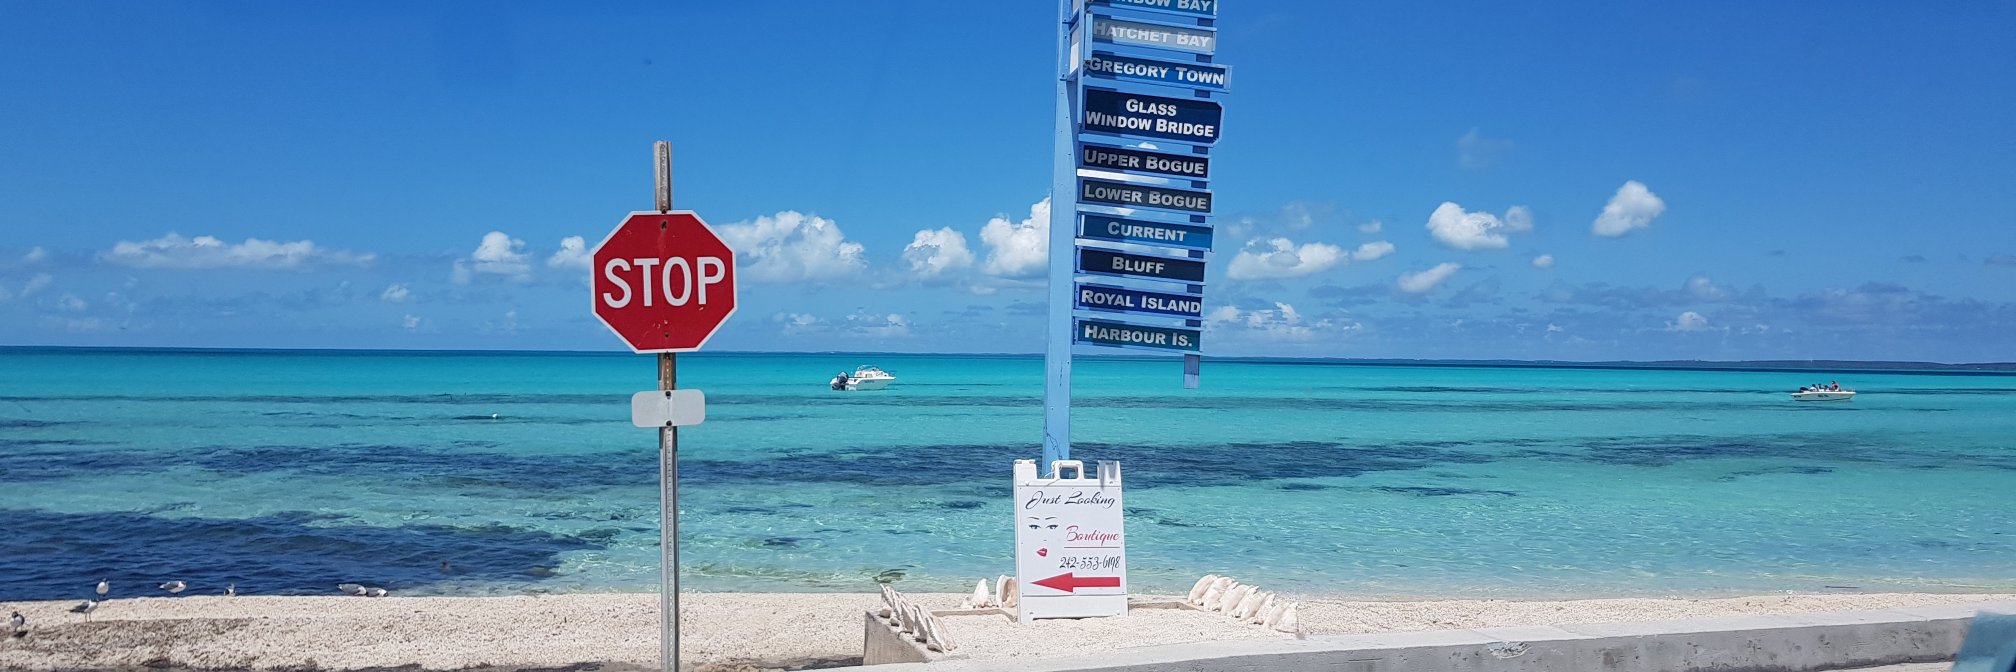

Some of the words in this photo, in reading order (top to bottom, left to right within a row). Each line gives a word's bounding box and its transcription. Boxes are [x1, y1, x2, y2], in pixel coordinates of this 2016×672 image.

[1177, 0, 1211, 12] BAY
[1093, 22, 1172, 43] HATCHET
[1176, 32, 1211, 48] BAY
[1089, 57, 1169, 79] GREGORY
[1175, 66, 1224, 85] TOWN
[1125, 98, 1177, 117] GLASS
[1085, 110, 1152, 131] WINDOW
[1156, 119, 1214, 138] BRIDGE
[1084, 149, 1140, 168] UPPER
[1145, 156, 1205, 175] BOGUE
[1084, 185, 1142, 203] LOWER
[1148, 191, 1207, 210] BOGUE
[1107, 221, 1187, 242] CURRENT
[1111, 256, 1165, 274] BLUFF
[603, 256, 726, 309] STOP
[1081, 289, 1135, 308] ROYAL
[1141, 295, 1200, 313] ISLAND
[1084, 324, 1166, 345] HARBOUR
[1171, 332, 1193, 347] IS.
[1025, 490, 1062, 510] Just
[1064, 491, 1116, 509] Looking
[1066, 525, 1120, 547] Boutique
